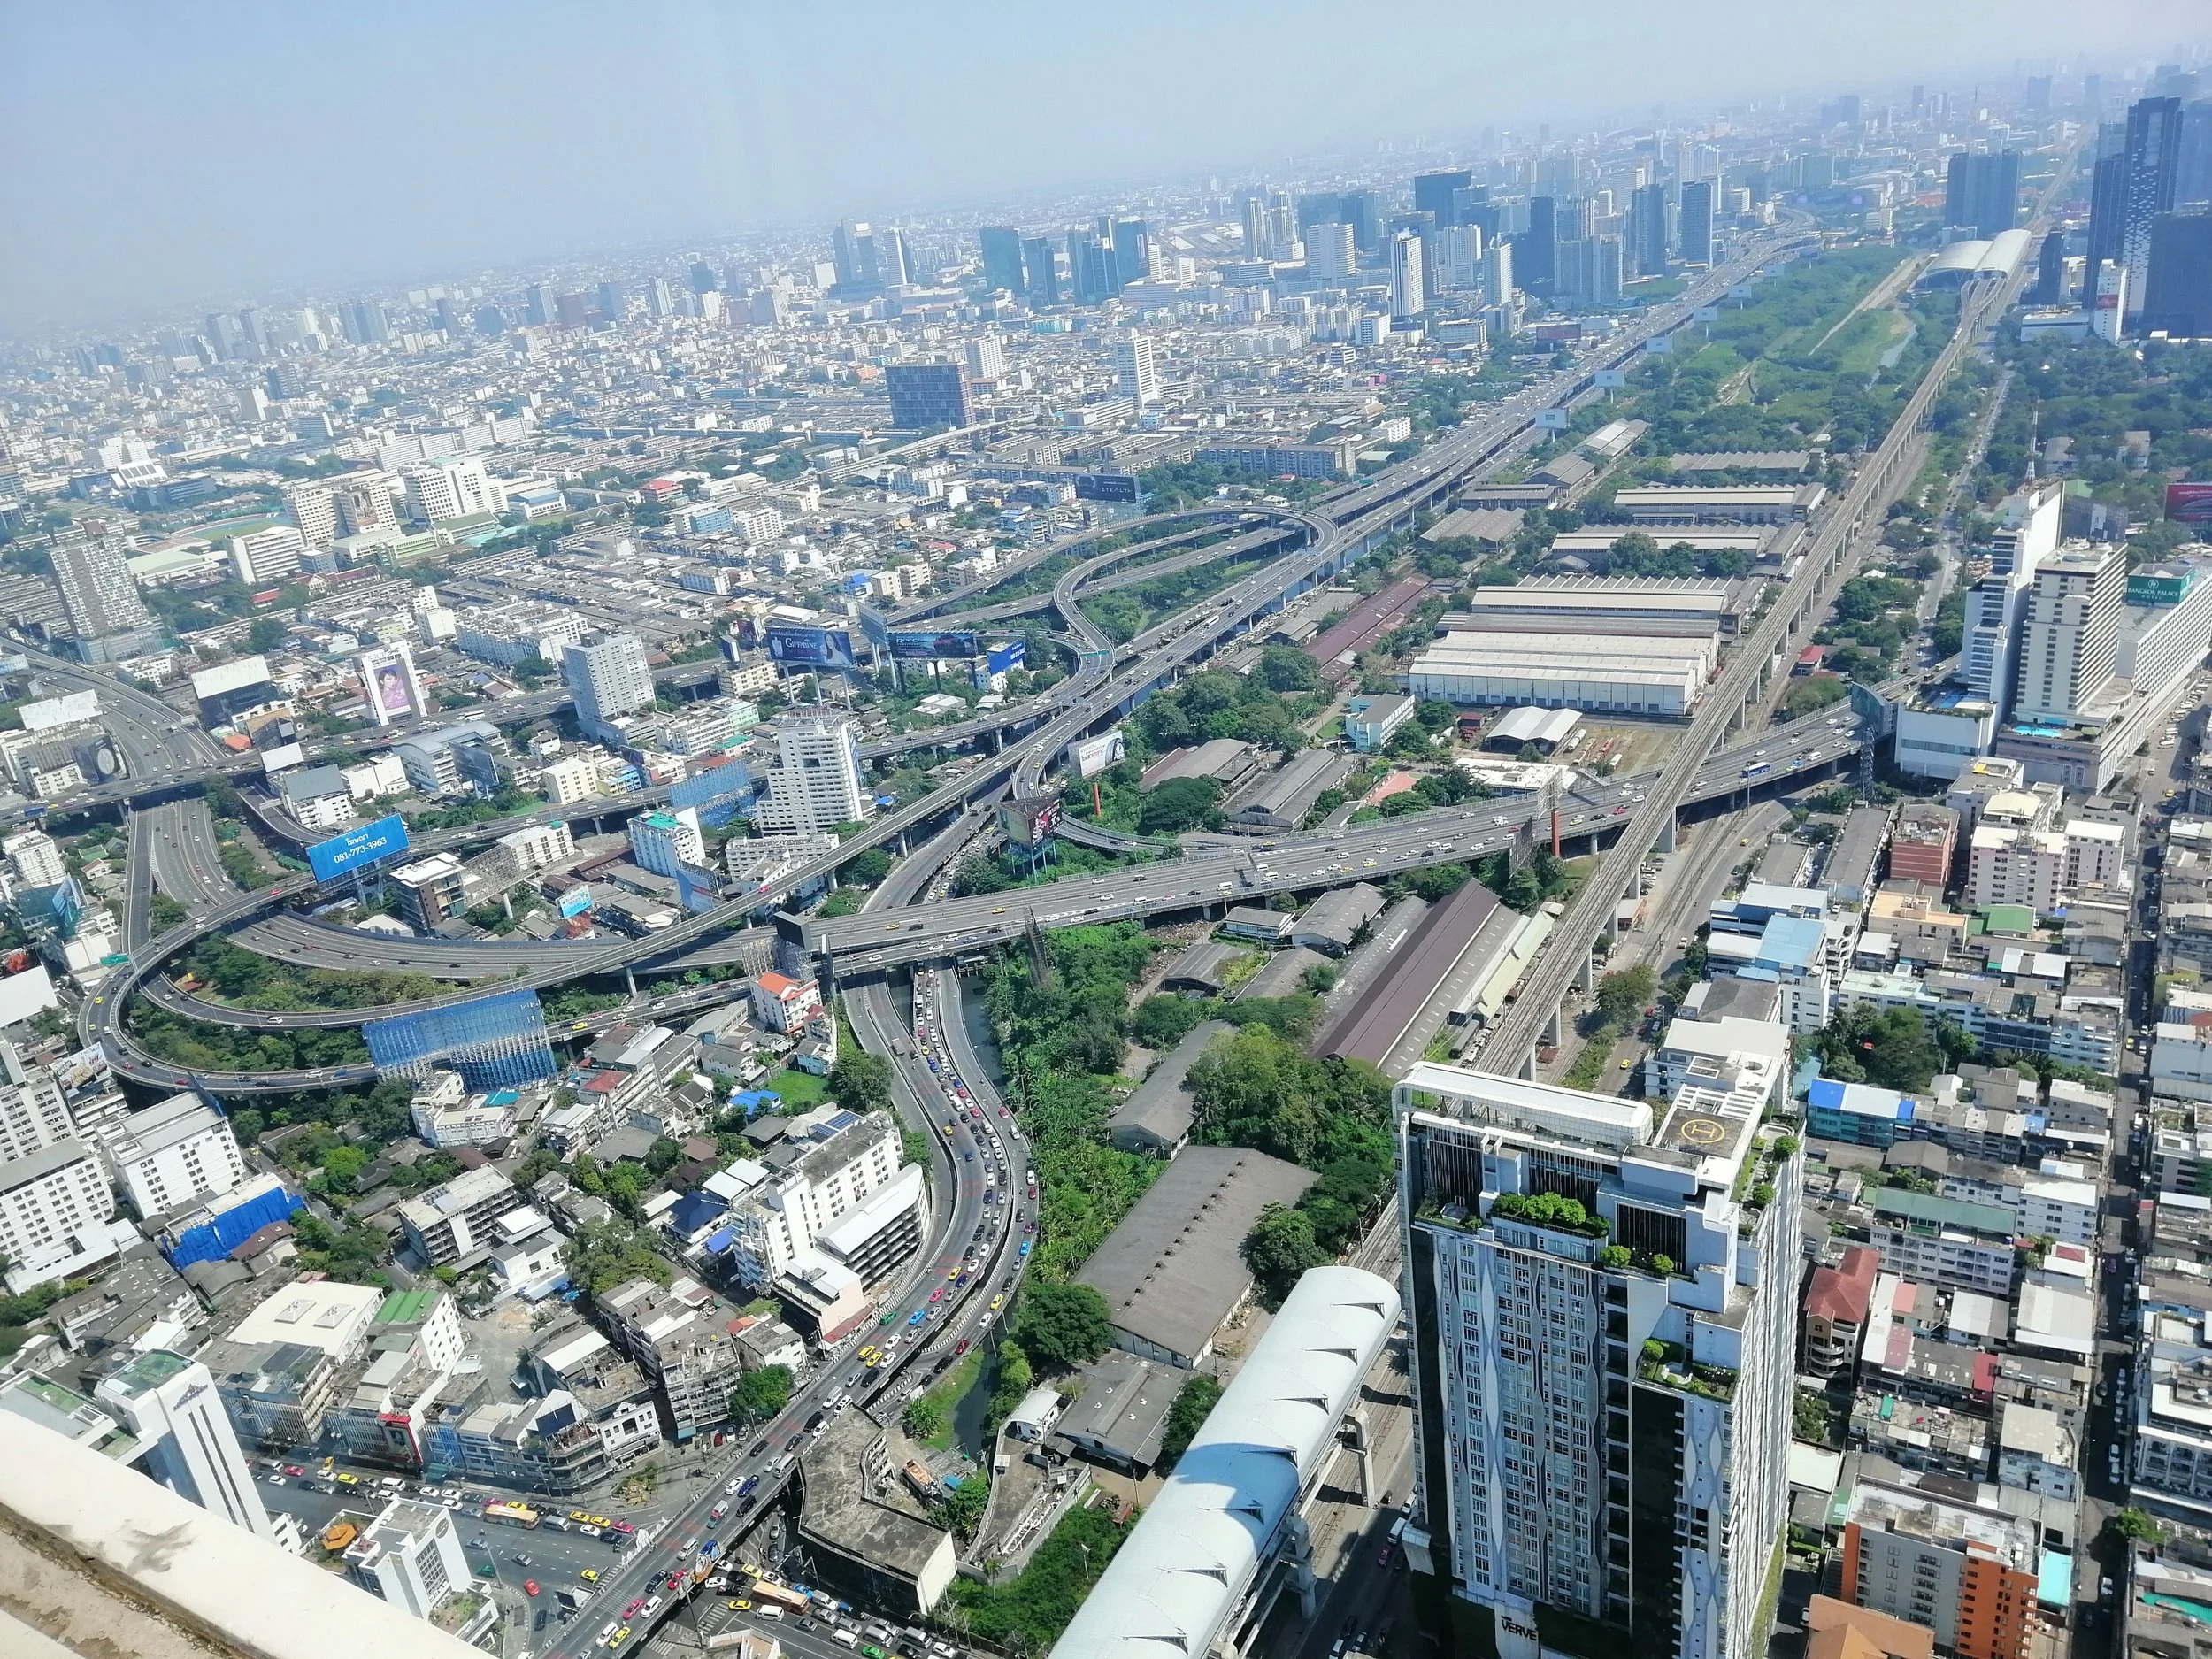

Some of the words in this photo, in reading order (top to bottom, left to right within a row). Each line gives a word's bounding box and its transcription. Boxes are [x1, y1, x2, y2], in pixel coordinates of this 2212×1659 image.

[334, 836, 388, 864] 081-773-3963
[345, 833, 369, 846] โฆษณา
[1501, 1619, 1537, 1641] VERVE
